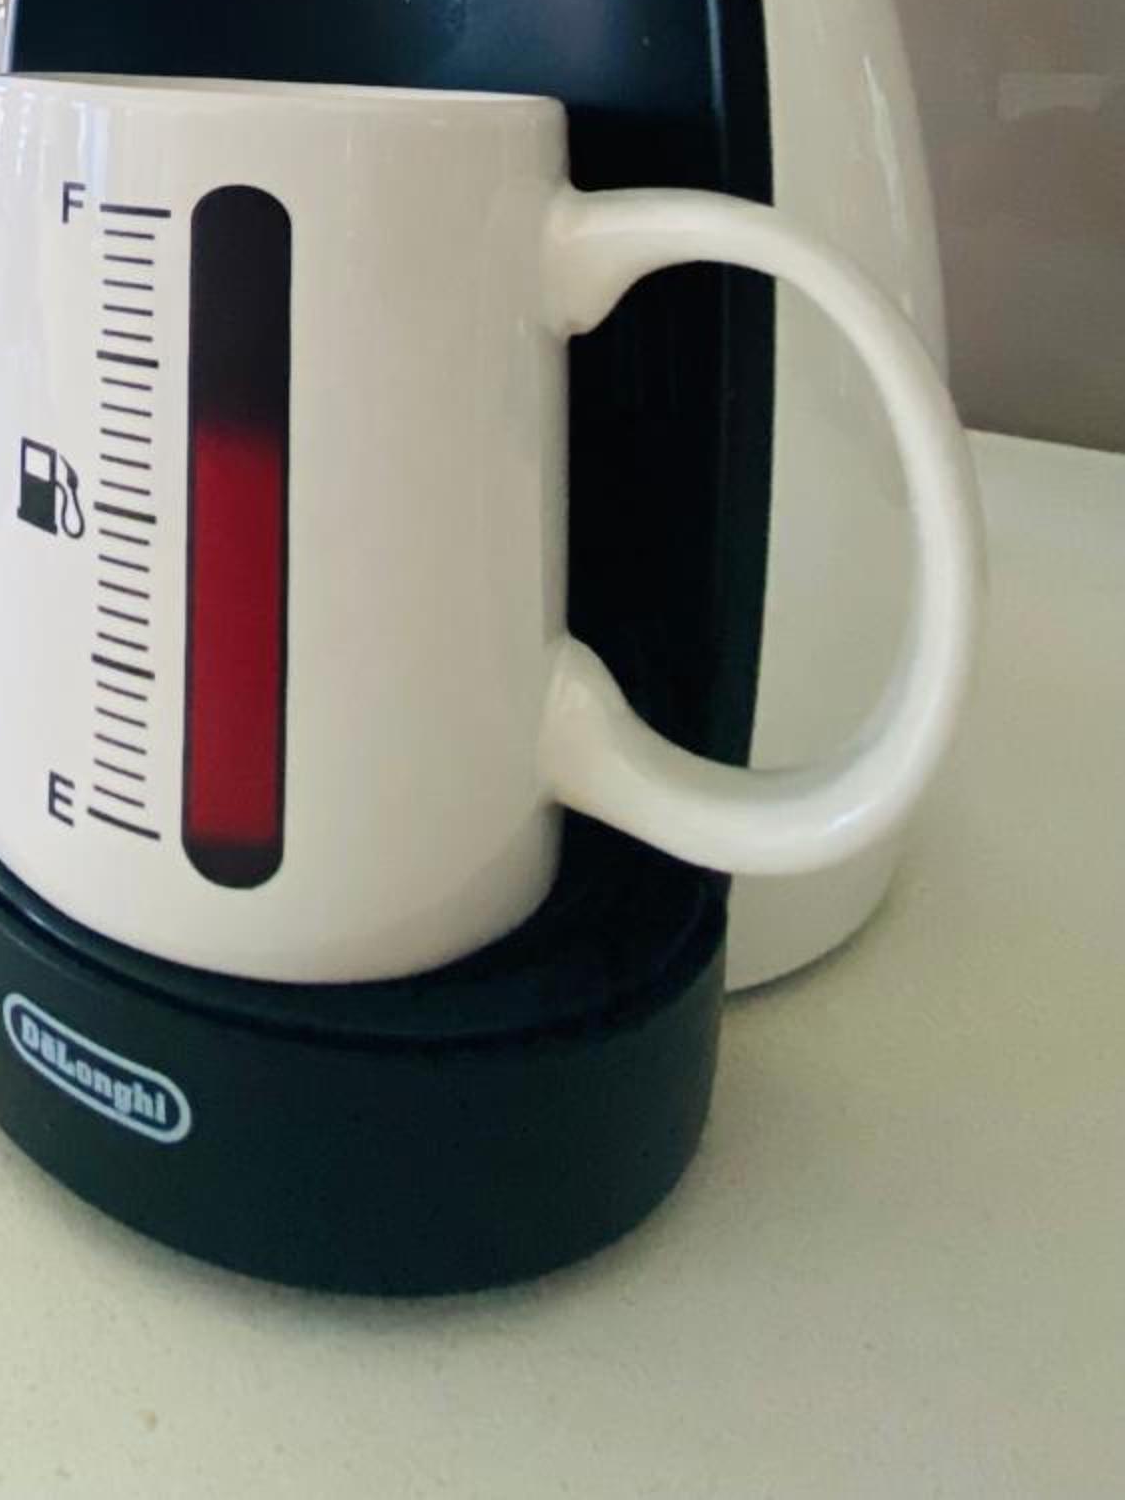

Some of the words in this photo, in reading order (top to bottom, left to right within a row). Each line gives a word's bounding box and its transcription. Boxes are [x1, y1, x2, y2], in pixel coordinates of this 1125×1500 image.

[62, 182, 86, 223] F
[48, 770, 75, 827] E
[20, 1013, 167, 1125] DeLonghi
